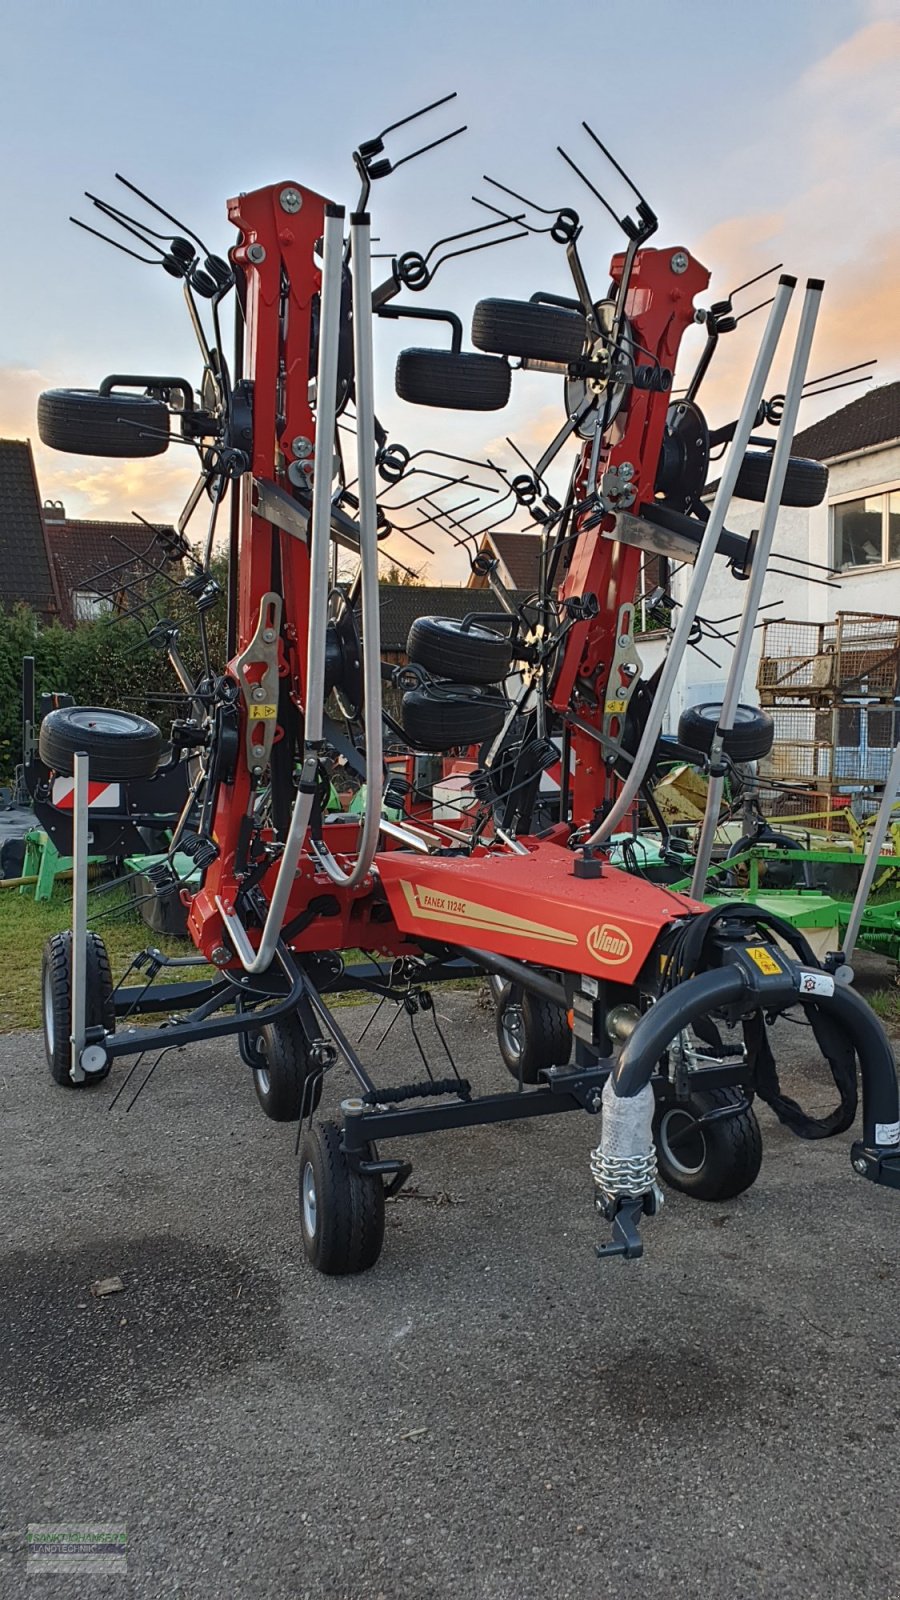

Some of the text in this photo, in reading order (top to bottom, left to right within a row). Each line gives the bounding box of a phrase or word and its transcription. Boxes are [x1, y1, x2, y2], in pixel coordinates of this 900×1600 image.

[424, 896, 466, 913] FANEX 1124C
[592, 924, 628, 957] Vicon
